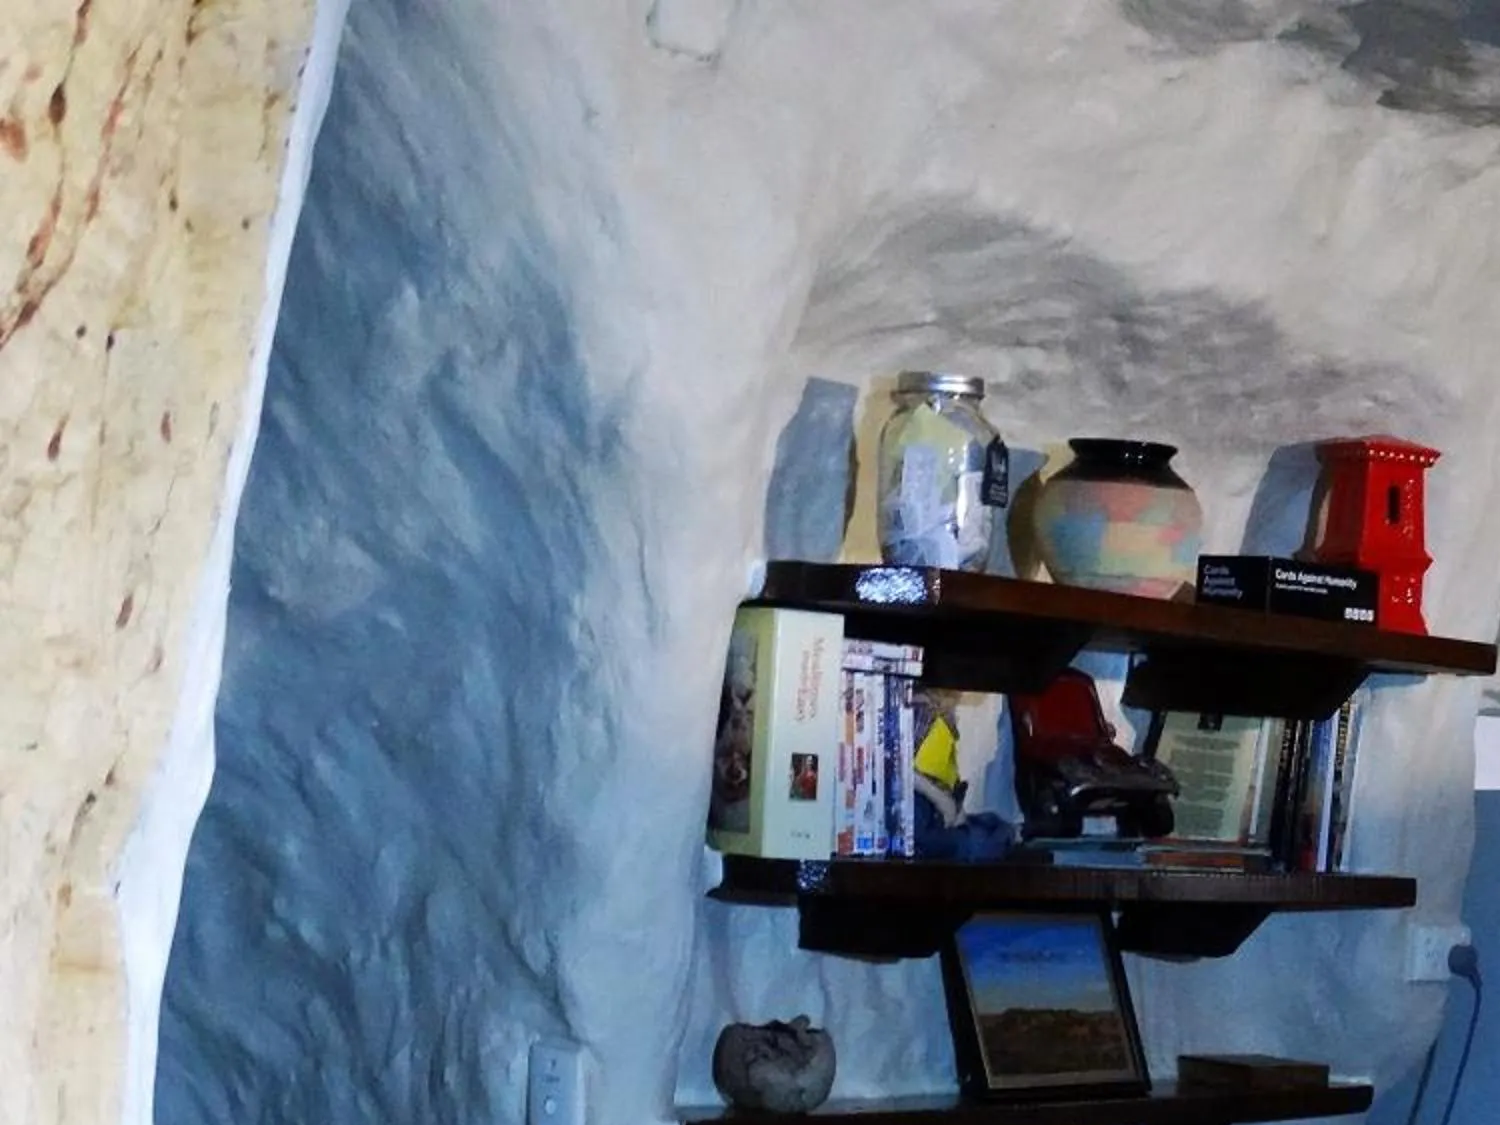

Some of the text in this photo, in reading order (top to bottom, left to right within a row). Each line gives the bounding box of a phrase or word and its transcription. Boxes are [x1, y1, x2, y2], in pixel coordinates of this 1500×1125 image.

[1275, 568, 1296, 581] Cards
[1298, 571, 1324, 585] Against
[1324, 575, 1358, 591] Humanity
